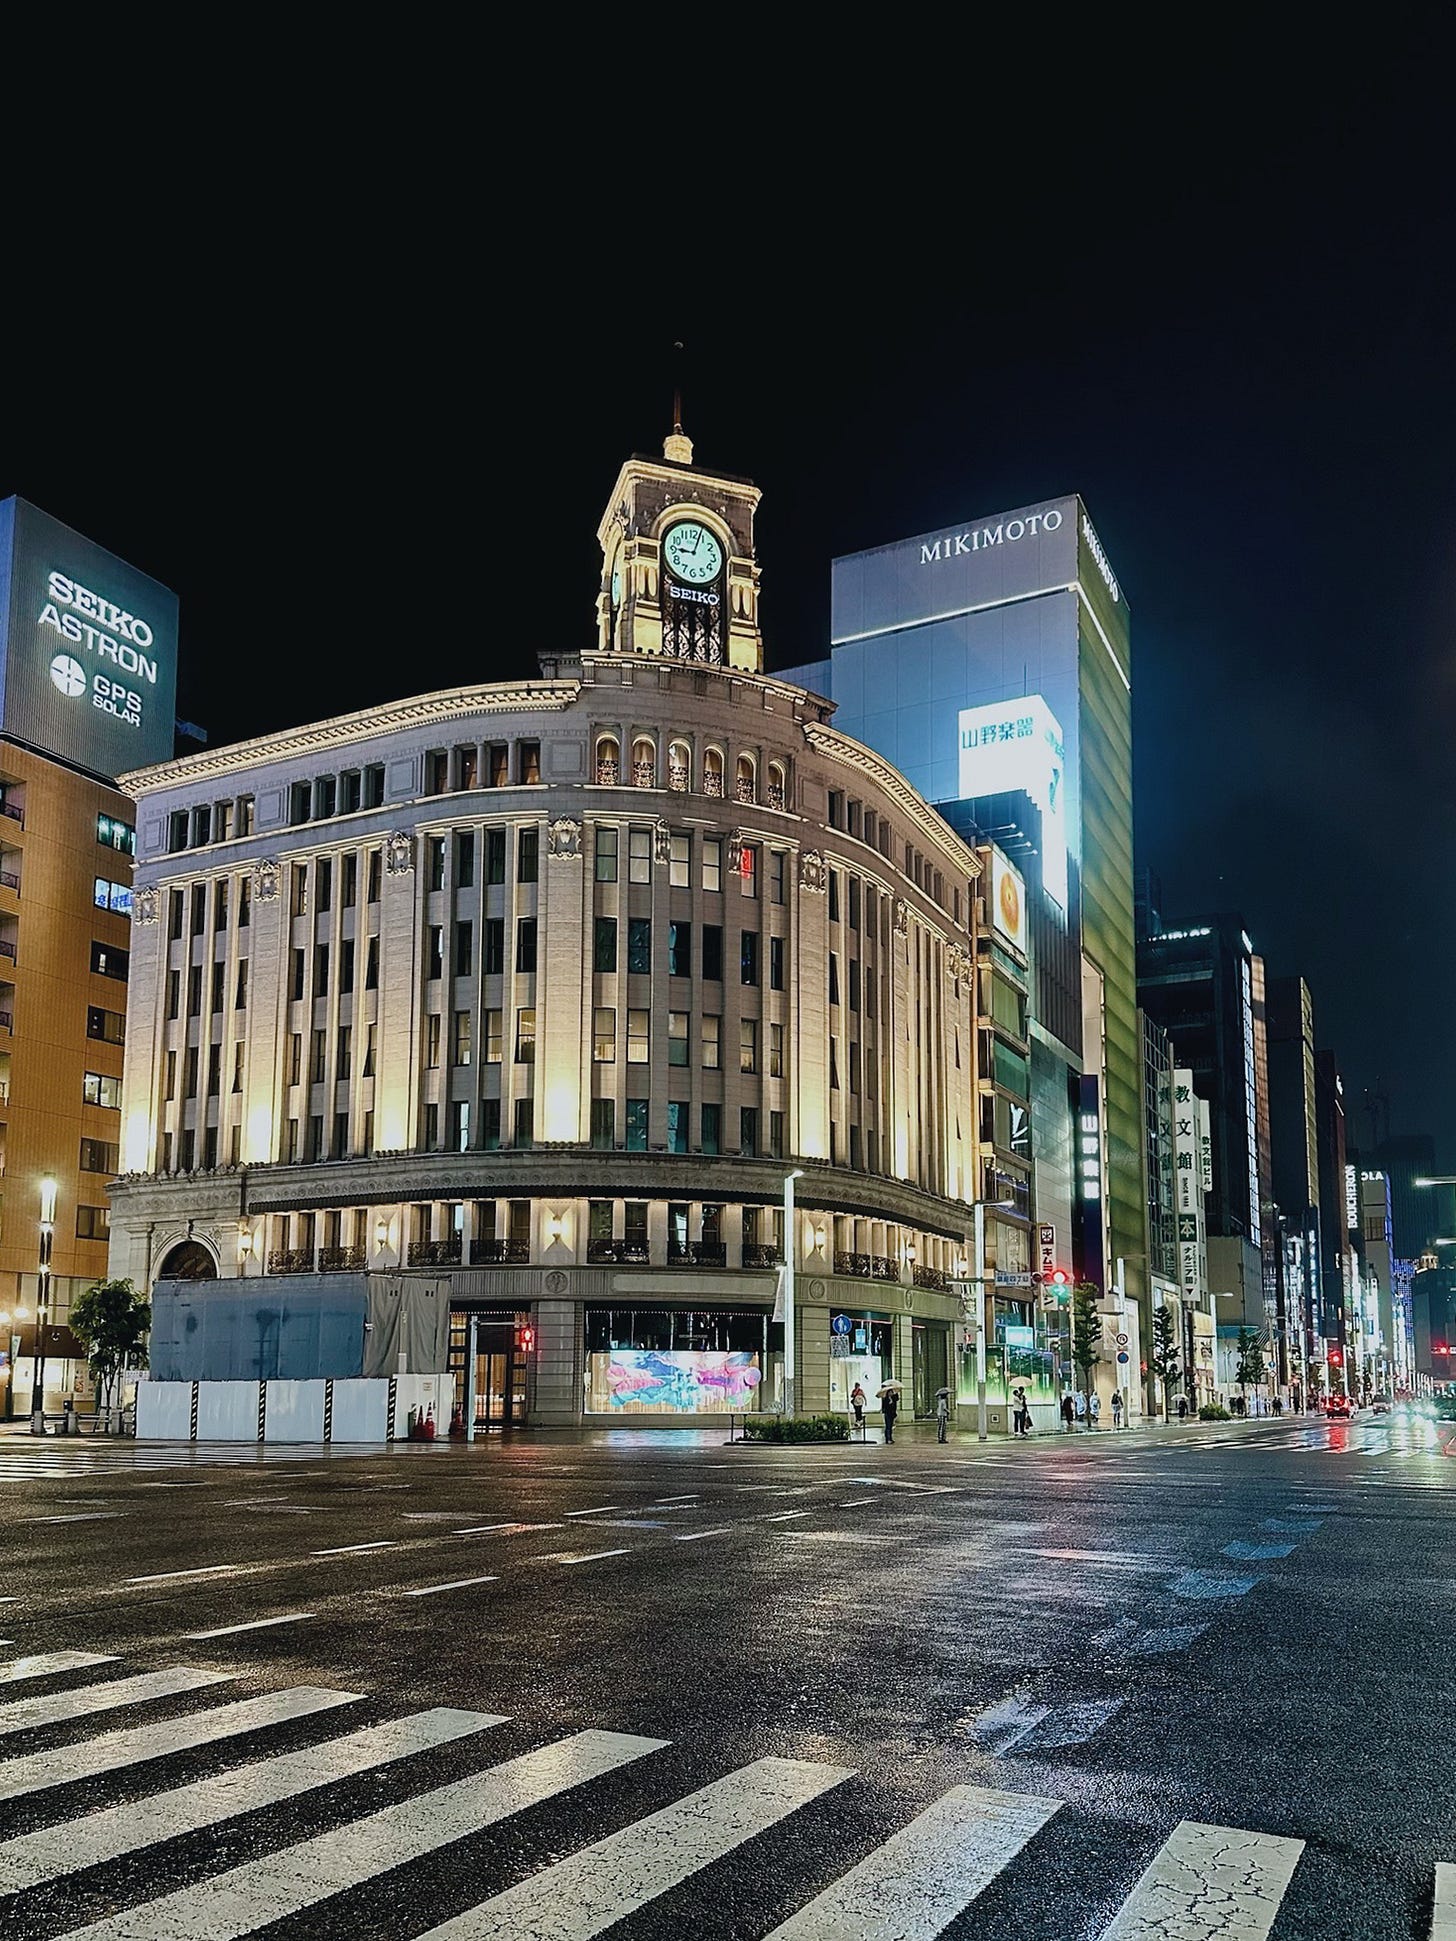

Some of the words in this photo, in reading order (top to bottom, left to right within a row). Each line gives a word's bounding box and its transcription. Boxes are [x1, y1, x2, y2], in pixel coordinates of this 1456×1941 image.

[681, 530, 688, 540] 11
[690, 530, 698, 539] 12
[701, 535, 705, 544] 1
[920, 510, 1063, 565] MIKIMOTO
[673, 536, 681, 546] 10
[670, 545, 677, 554] 9
[707, 543, 713, 552] 2
[673, 555, 680, 565] 8
[710, 554, 716, 563] 3
[681, 564, 688, 573] 7
[690, 569, 696, 577] 6
[699, 568, 705, 577] 5
[670, 586, 719, 605] SEIKO
[48, 570, 153, 647] SEIKO
[38, 604, 157, 684] ASTRON
[93, 674, 142, 713] GPS
[92, 694, 141, 728] SOLAR
[1174, 1084, 1193, 1171] 教文館
[1344, 1164, 1359, 1229] BOUCHERON
[1180, 1218, 1196, 1239] 本
